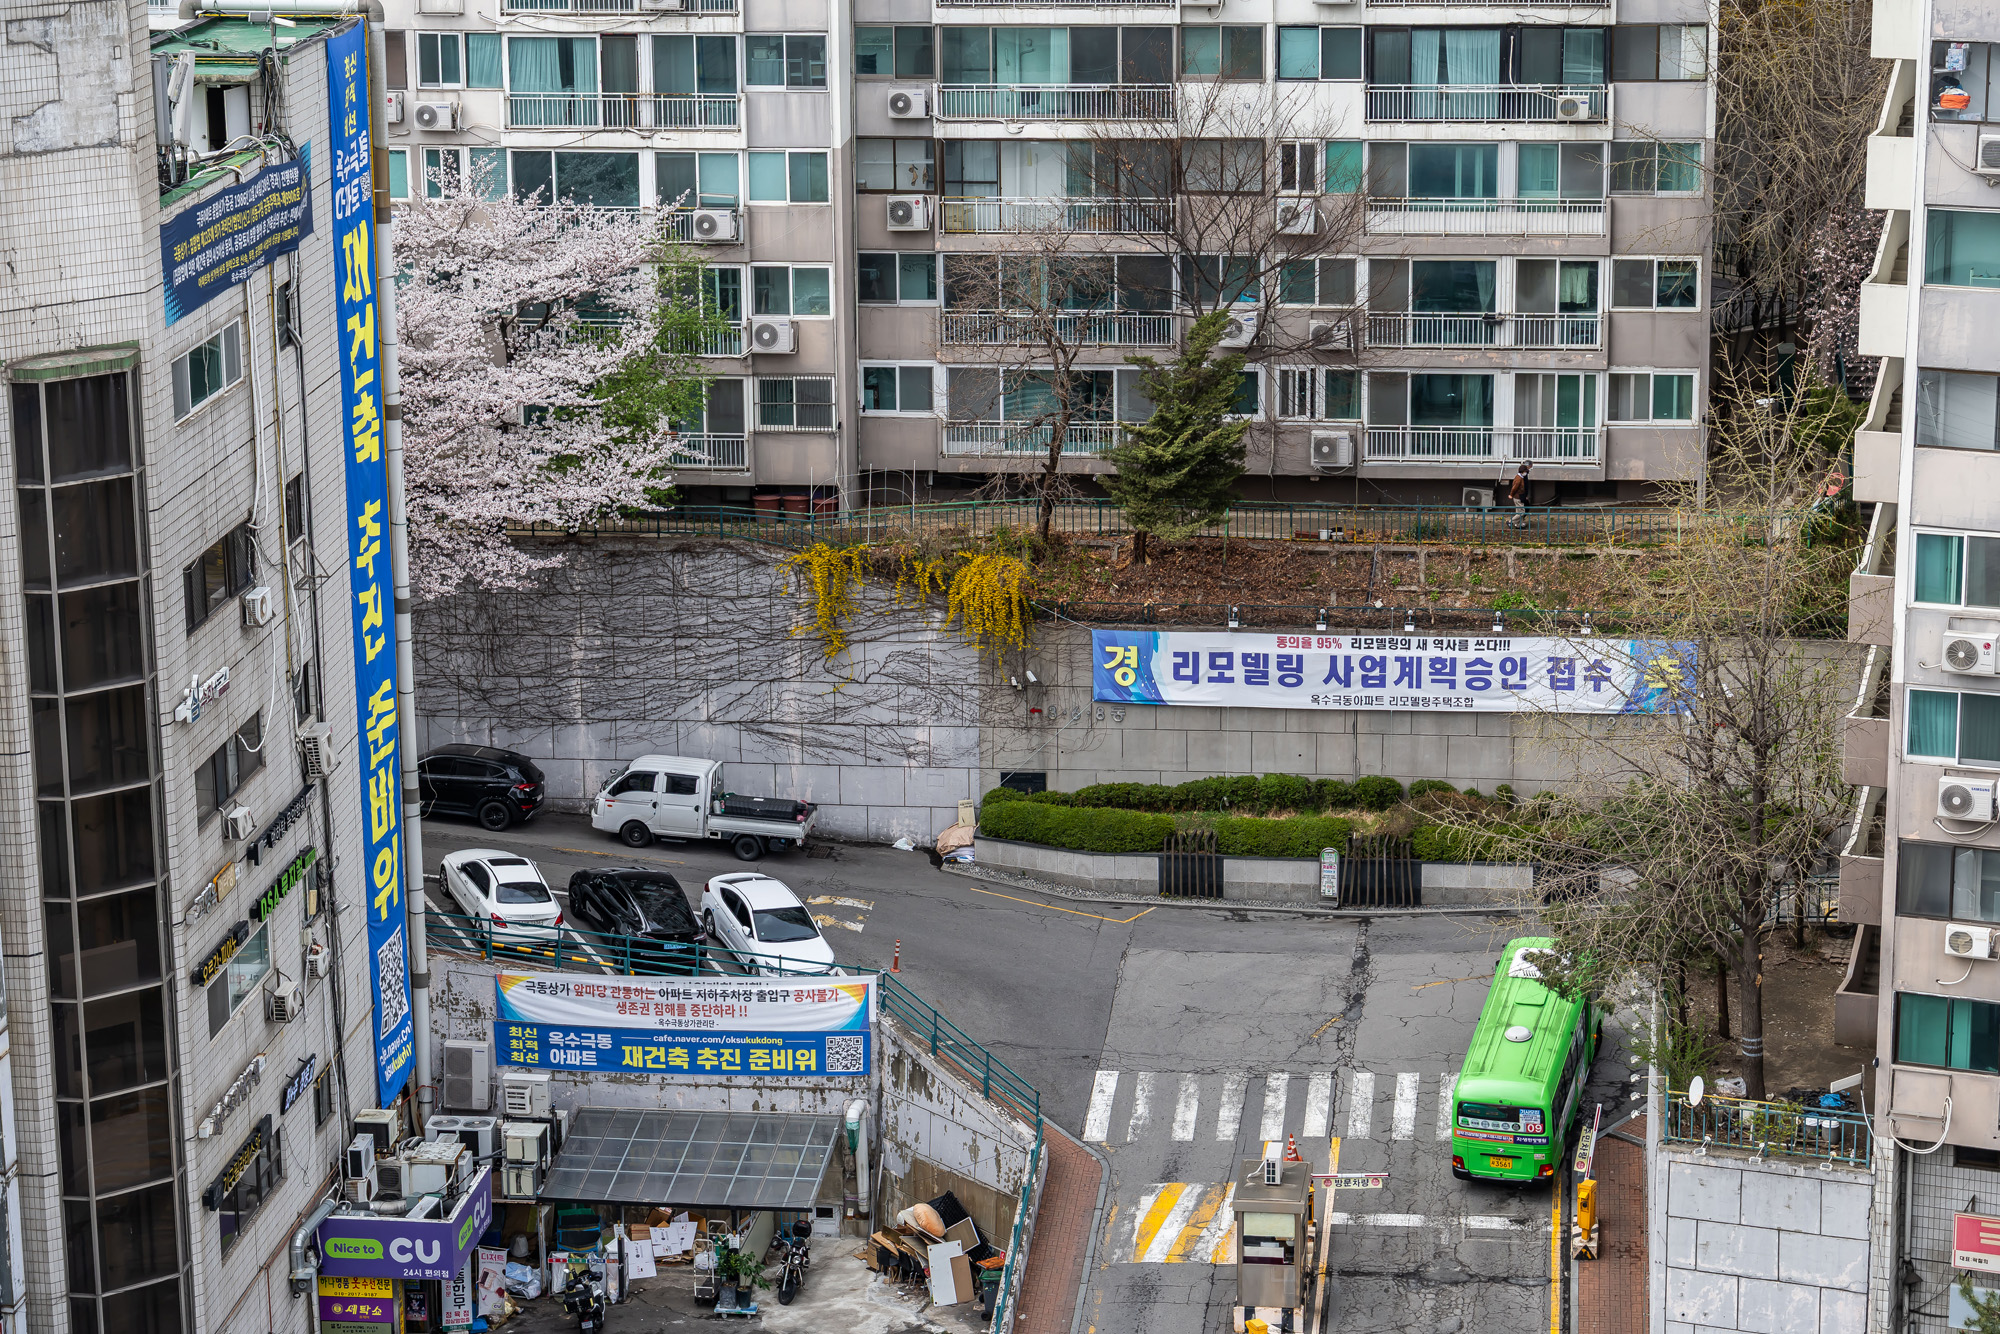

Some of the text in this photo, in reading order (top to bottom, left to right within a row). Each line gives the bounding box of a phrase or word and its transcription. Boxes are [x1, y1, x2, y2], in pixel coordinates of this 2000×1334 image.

[336, 130, 369, 183] 옥수극동
[343, 220, 398, 923] 재건축 추진 준비위
[1276, 636, 1511, 652] 동의율 95% 리모델링의 새 역사를 쓰다!!!
[1103, 645, 1139, 687] 경
[1172, 651, 1305, 688] 리모델링
[1322, 654, 1528, 690] 사업계획승인
[1546, 656, 1612, 693] 접수
[1310, 694, 1474, 709] 옥수극동아파트 리모델링주택조합
[261, 884, 280, 922] DSA
[281, 856, 303, 897] 뮤지컬
[525, 980, 839, 1003] 극동상가 앞마당 관통하는 아파트 지하주차장 출입구 공사불가
[616, 1001, 748, 1018] 생존권 침해를 중단하라 !!
[509, 1026, 538, 1038] 최신
[653, 1033, 783, 1046] cafe.naver.com/oksukukdong
[509, 1039, 539, 1051] 최적
[548, 1031, 613, 1050] 옥수극동
[511, 1051, 539, 1064] 최선
[550, 1048, 598, 1067] 아파트
[621, 1045, 817, 1071] 재건축 추진 준비위
[1527, 1124, 1542, 1133] 09
[1334, 1178, 1369, 1188] 방문차량
[473, 1190, 487, 1228] CU
[333, 1243, 376, 1254] Nice to
[389, 1237, 441, 1265] CU
[481, 1252, 504, 1262] 디저트
[403, 1269, 449, 1279] 24시 편의점
[351, 1276, 360, 1290] 옷
